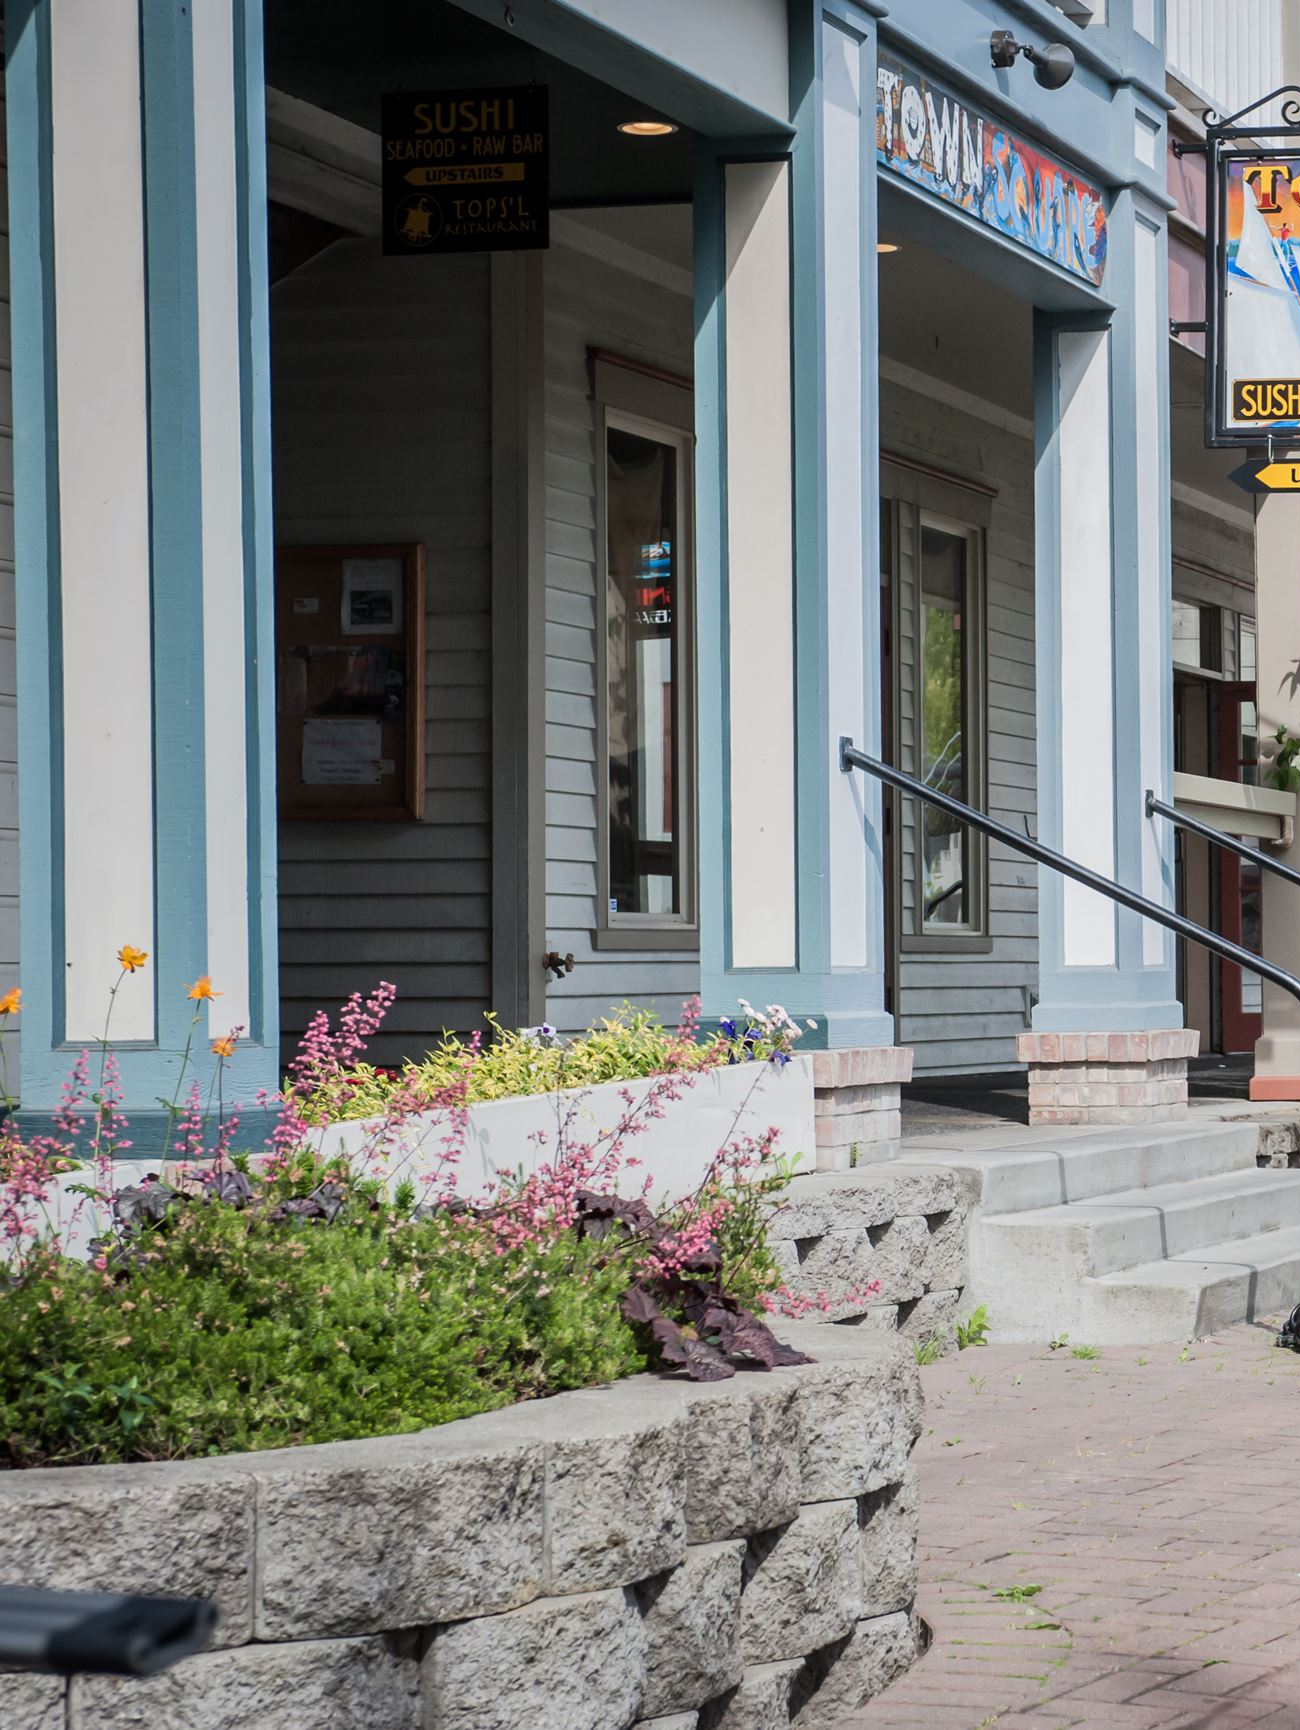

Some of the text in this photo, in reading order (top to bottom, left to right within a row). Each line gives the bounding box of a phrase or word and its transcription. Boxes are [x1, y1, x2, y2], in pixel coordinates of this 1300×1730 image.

[414, 98, 515, 135] SUSHI
[878, 67, 984, 193] TOWN
[386, 133, 544, 160] SEAFOOD RAW BAR
[425, 166, 504, 183] UPSTAIRS
[452, 195, 529, 219] TOPS'L
[445, 220, 538, 235] RESTAURANT
